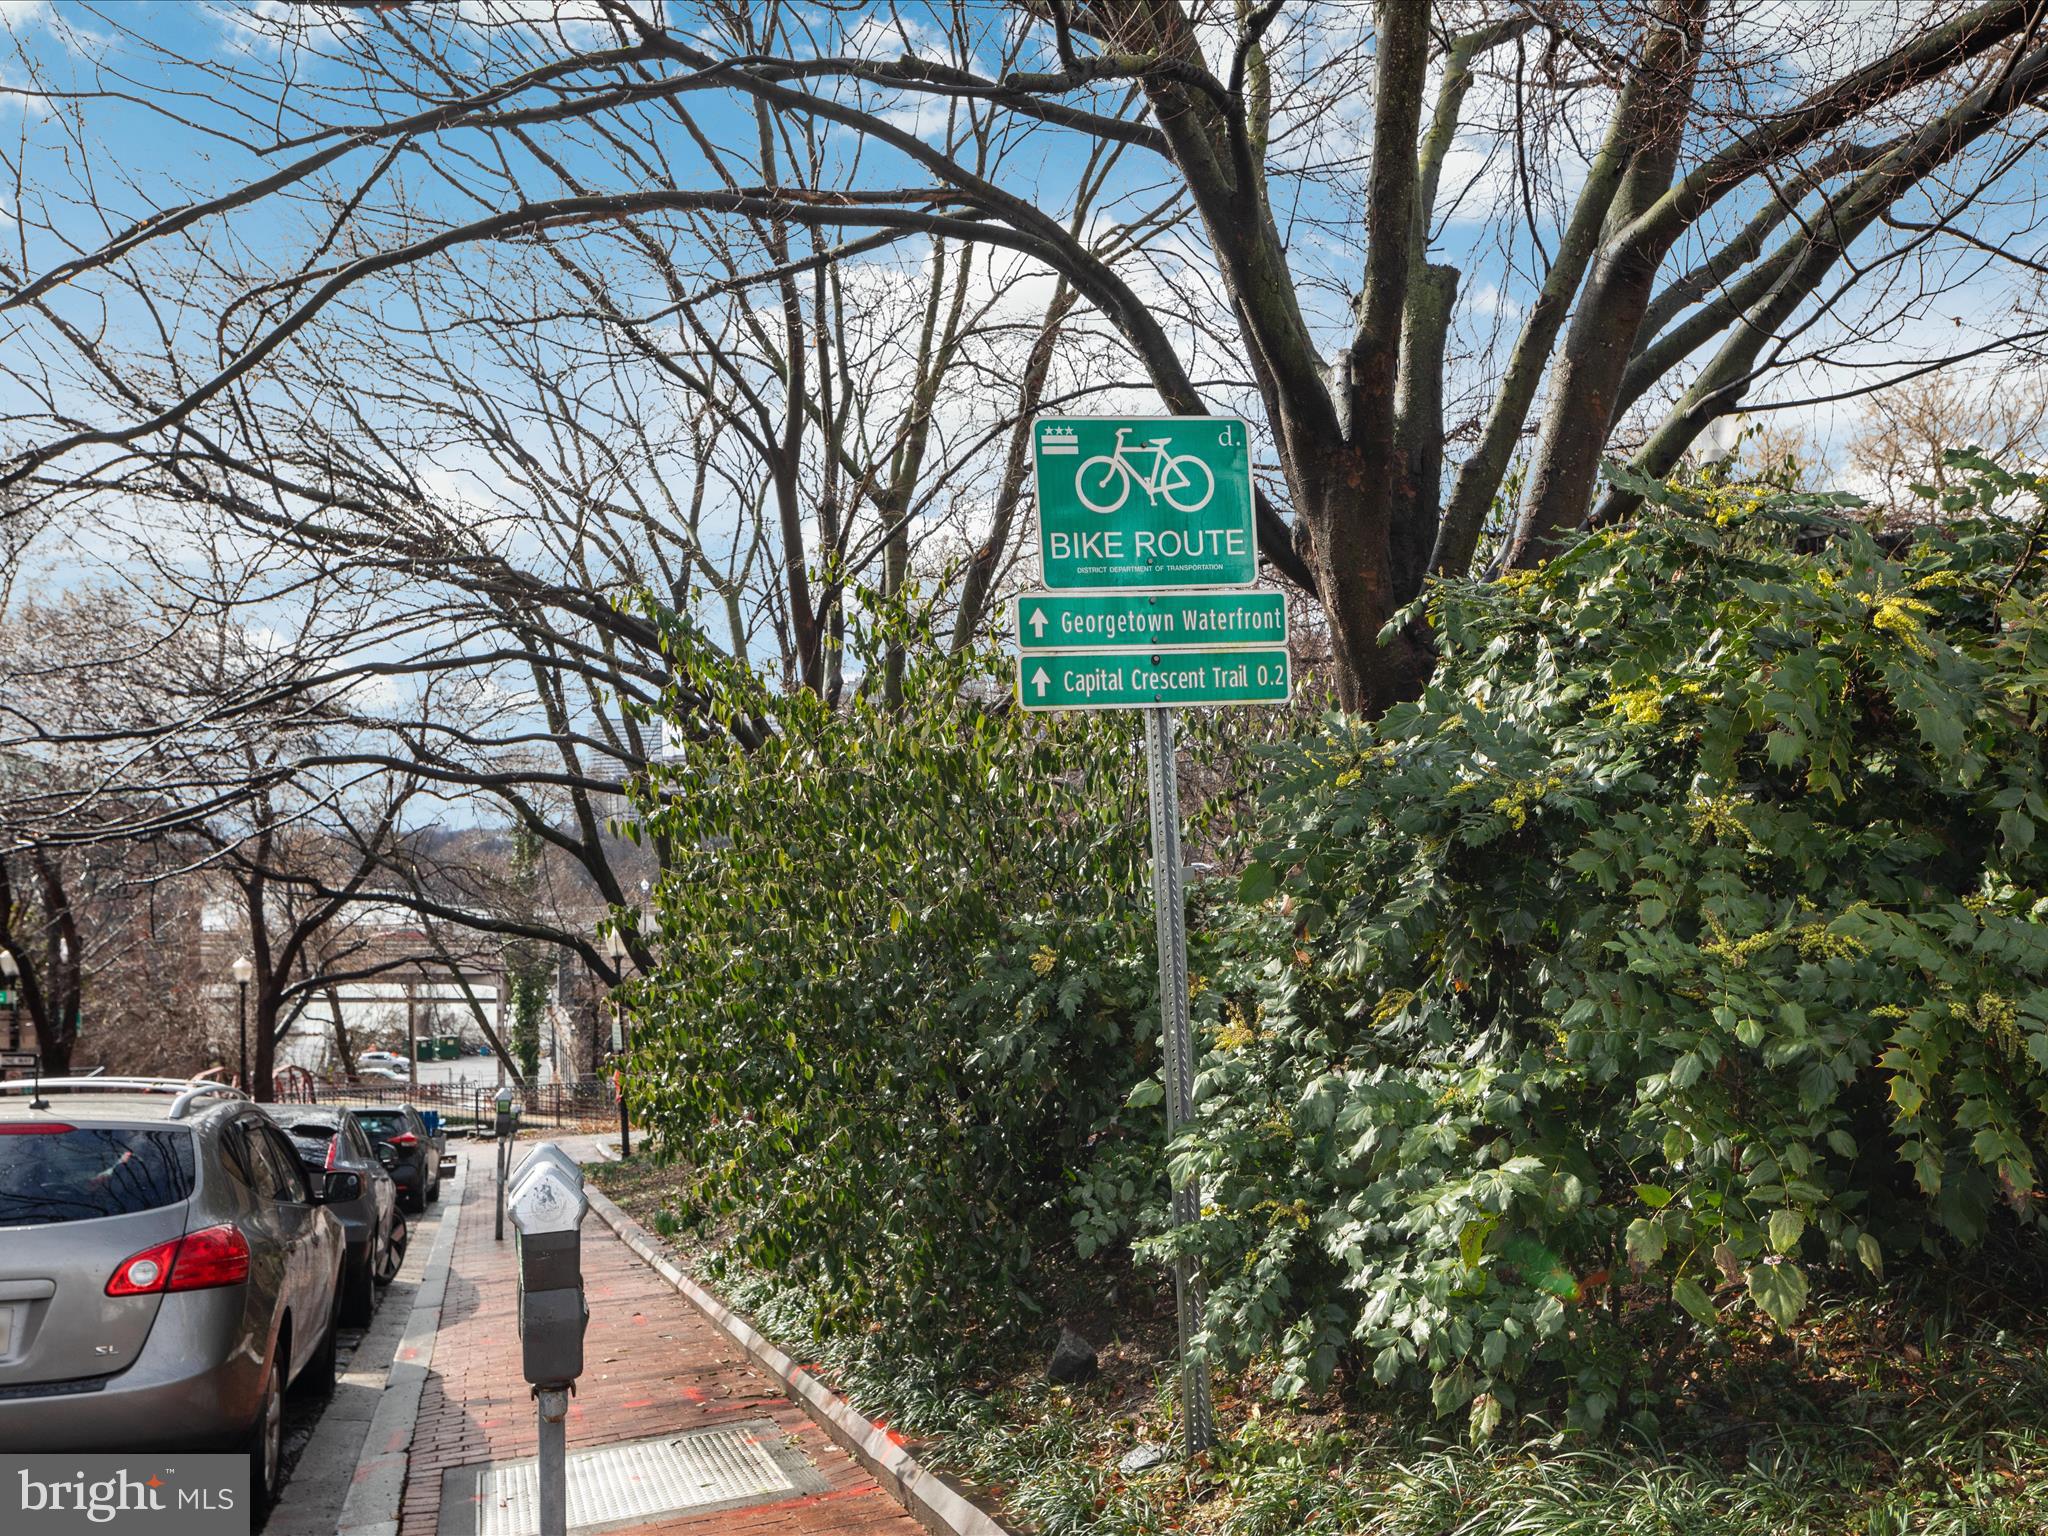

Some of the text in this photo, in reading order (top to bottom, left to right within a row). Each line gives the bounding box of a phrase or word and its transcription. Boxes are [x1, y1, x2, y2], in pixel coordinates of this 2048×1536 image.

[1218, 425, 1241, 447] d.
[1051, 529, 1246, 559] BIKE ROUTE
[1061, 607, 1282, 638] Georgetown Waterfront
[1064, 665, 1284, 697] Capital Crescent Trail 0.2
[95, 1345, 119, 1355] SL
